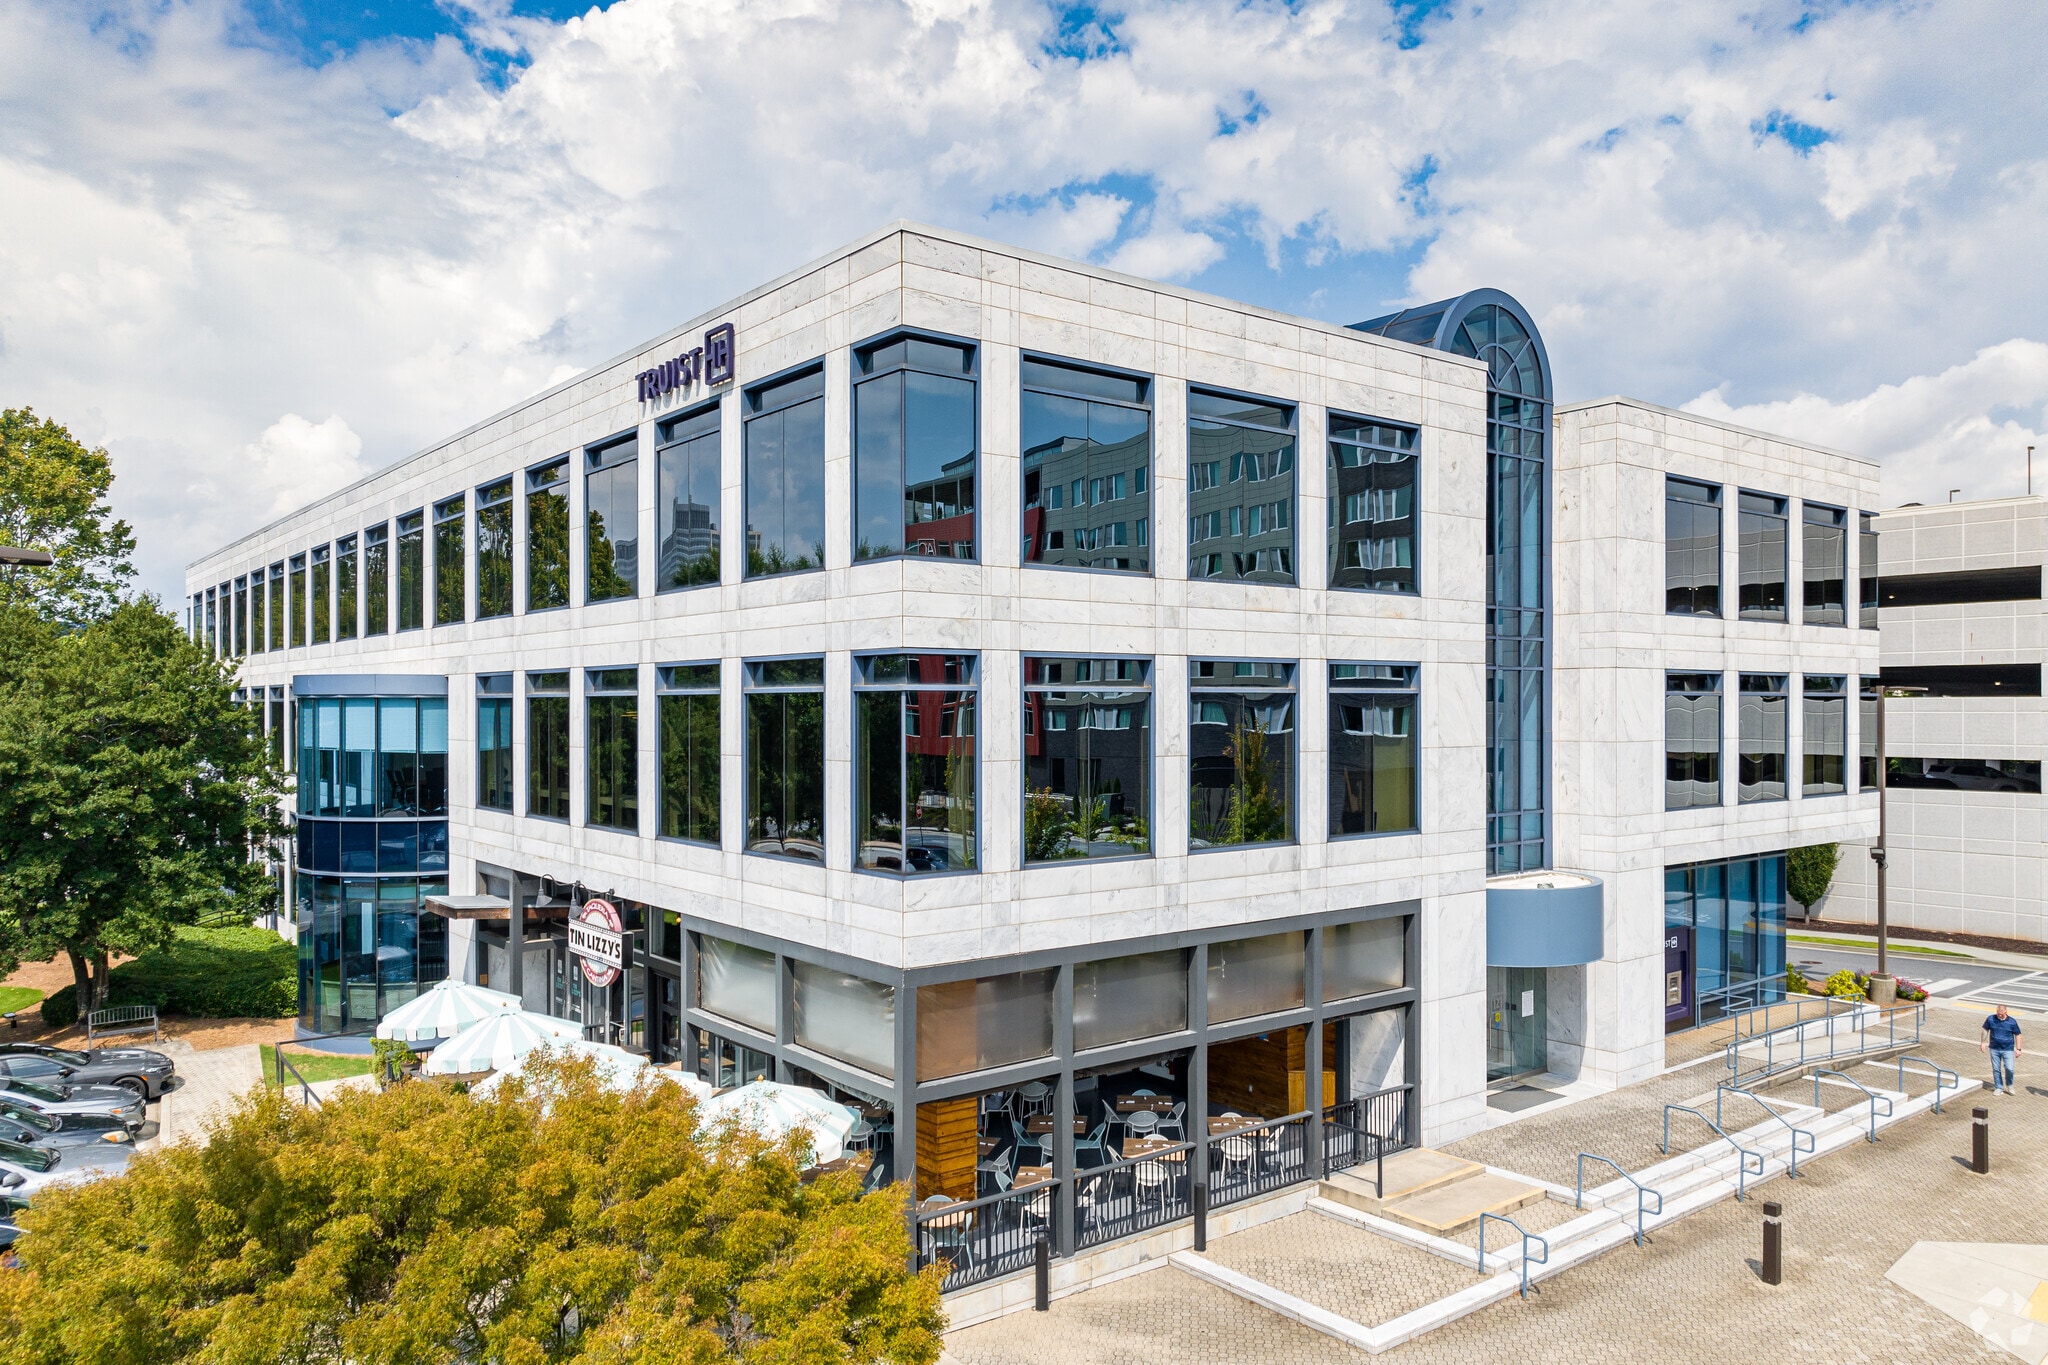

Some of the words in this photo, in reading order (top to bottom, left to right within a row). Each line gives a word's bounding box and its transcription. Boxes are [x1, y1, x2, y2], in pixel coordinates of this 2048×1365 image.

[635, 347, 703, 402] TRUIST
[570, 928, 584, 947] TIN
[587, 934, 620, 959] LIZZY'S
[586, 967, 608, 984] CANTINA
